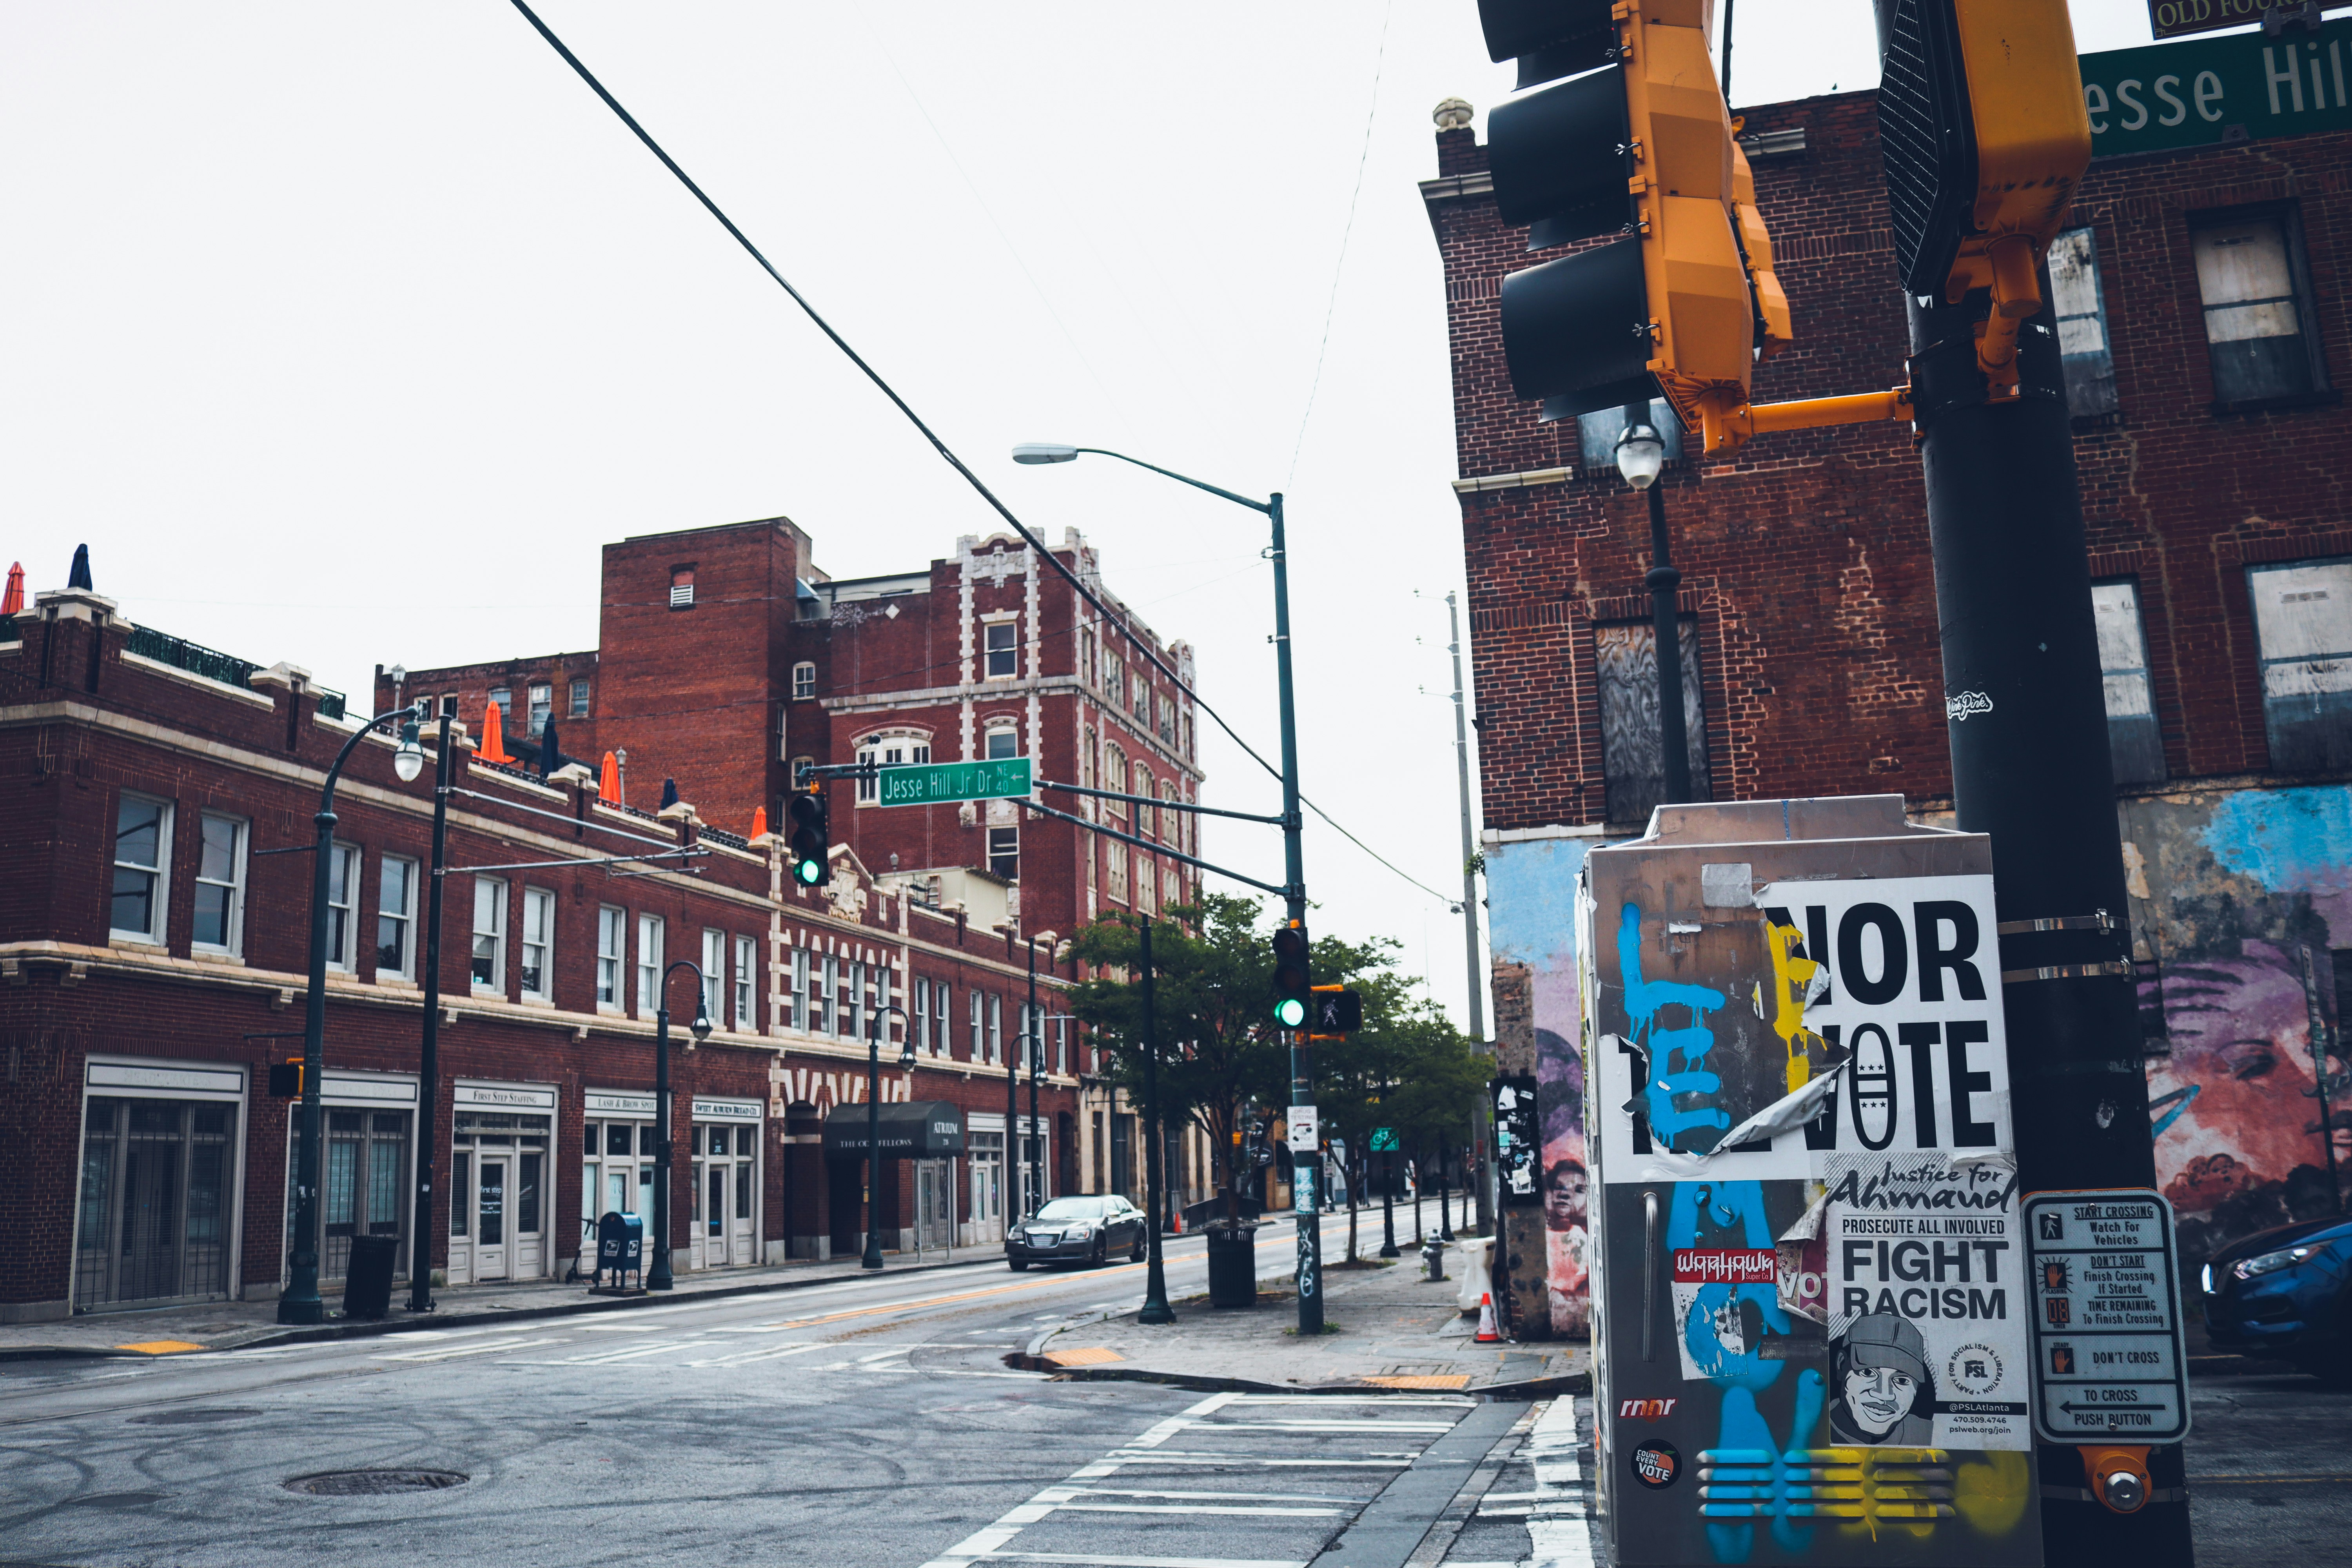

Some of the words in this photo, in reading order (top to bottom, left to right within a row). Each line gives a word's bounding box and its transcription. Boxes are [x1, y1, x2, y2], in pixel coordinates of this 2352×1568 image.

[2157, 0, 2210, 27] OLD
[2083, 71, 2223, 134] esse
[2262, 39, 2352, 114] Hil
[997, 764, 1008, 777] NE
[885, 775, 922, 800] Jesse
[930, 772, 950, 797] Hill
[957, 771, 970, 794] Jr
[978, 770, 991, 793] Dr
[996, 780, 1009, 793] 40
[474, 1090, 491, 1101] FIRST
[492, 1092, 508, 1103] STEP
[509, 1093, 537, 1104] STAFFING
[598, 1098, 613, 1108] LASH
[641, 1100, 655, 1110] SPOT
[933, 1122, 958, 1135] ATRIUM
[1880, 1161, 1963, 1187] Justice
[1969, 1162, 2003, 1191] for
[1826, 1169, 2018, 1213] Ahmaud
[2074, 1207, 2102, 1218] START
[2106, 1206, 2153, 1217] CROSSING
[1843, 1219, 1914, 1234] PROSECUTE
[1918, 1220, 1940, 1234] ALL
[1945, 1220, 2005, 1234] INVOLVED
[2090, 1222, 2121, 1233] Watch
[2125, 1221, 2140, 1232] For
[2094, 1234, 2138, 1245] Vehicles
[1843, 1240, 2009, 1283] FIGHT
[2091, 1255, 2117, 1267] DON'T
[2120, 1255, 2145, 1267] START
[1746, 1272, 1761, 1281] Super
[2084, 1271, 2113, 1282] Finish
[2116, 1271, 2154, 1284] Crossing
[2098, 1284, 2106, 1294] If
[2109, 1284, 2143, 1294] Started
[1843, 1287, 2007, 1319] RACISM
[2087, 1301, 2107, 1312] TIME
[2109, 1299, 2156, 1311] REMAINING
[2083, 1314, 2092, 1325] To
[2095, 1313, 2123, 1325] Finish
[2125, 1313, 2164, 1327] Crossing
[2093, 1352, 2124, 1364] DON'T
[2127, 1351, 2160, 1364] CROSS
[1951, 1378, 1974, 1395] PARTY
[1982, 1356, 2003, 1394] LIBERATION
[1965, 1365, 1988, 1378] PSL
[2084, 1390, 2098, 1401] TO
[2102, 1389, 2138, 1402] CROSS
[1949, 1403, 2010, 1412] @PSLAtlanta
[2074, 1414, 2104, 1426] PUSH
[2109, 1414, 2152, 1425] BUTTON
[1949, 1426, 2011, 1435] pslweb.org/join
[1635, 1455, 1659, 1466] EVERY
[1637, 1449, 1660, 1461] COUNT
[1639, 1462, 1671, 1481] VOTE
